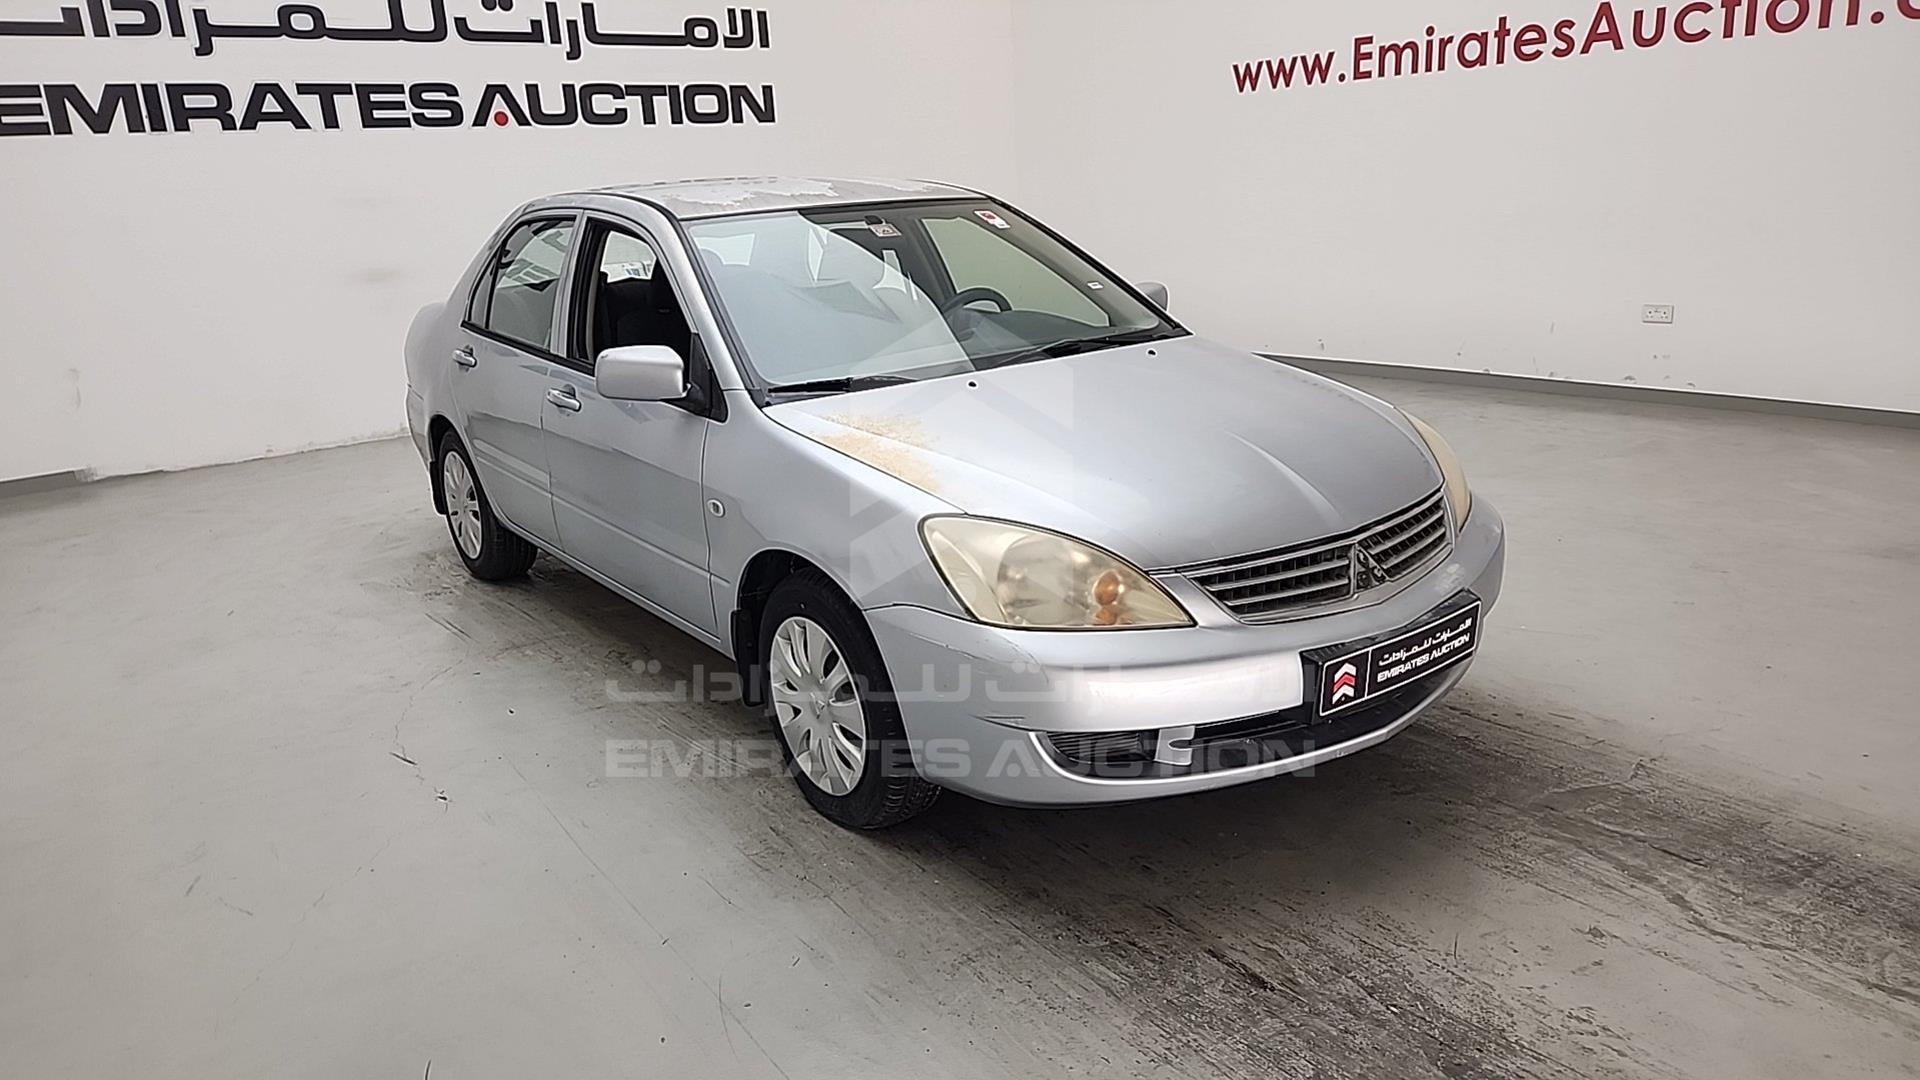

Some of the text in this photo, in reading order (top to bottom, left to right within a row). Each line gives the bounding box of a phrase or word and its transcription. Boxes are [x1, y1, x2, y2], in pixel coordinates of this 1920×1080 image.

[1232, 0, 1920, 93] www.EmiratesAuction.
[0, 83, 776, 136] EMIRATES AUCTION
[1377, 632, 1470, 683] EMIRATES AUCTION
